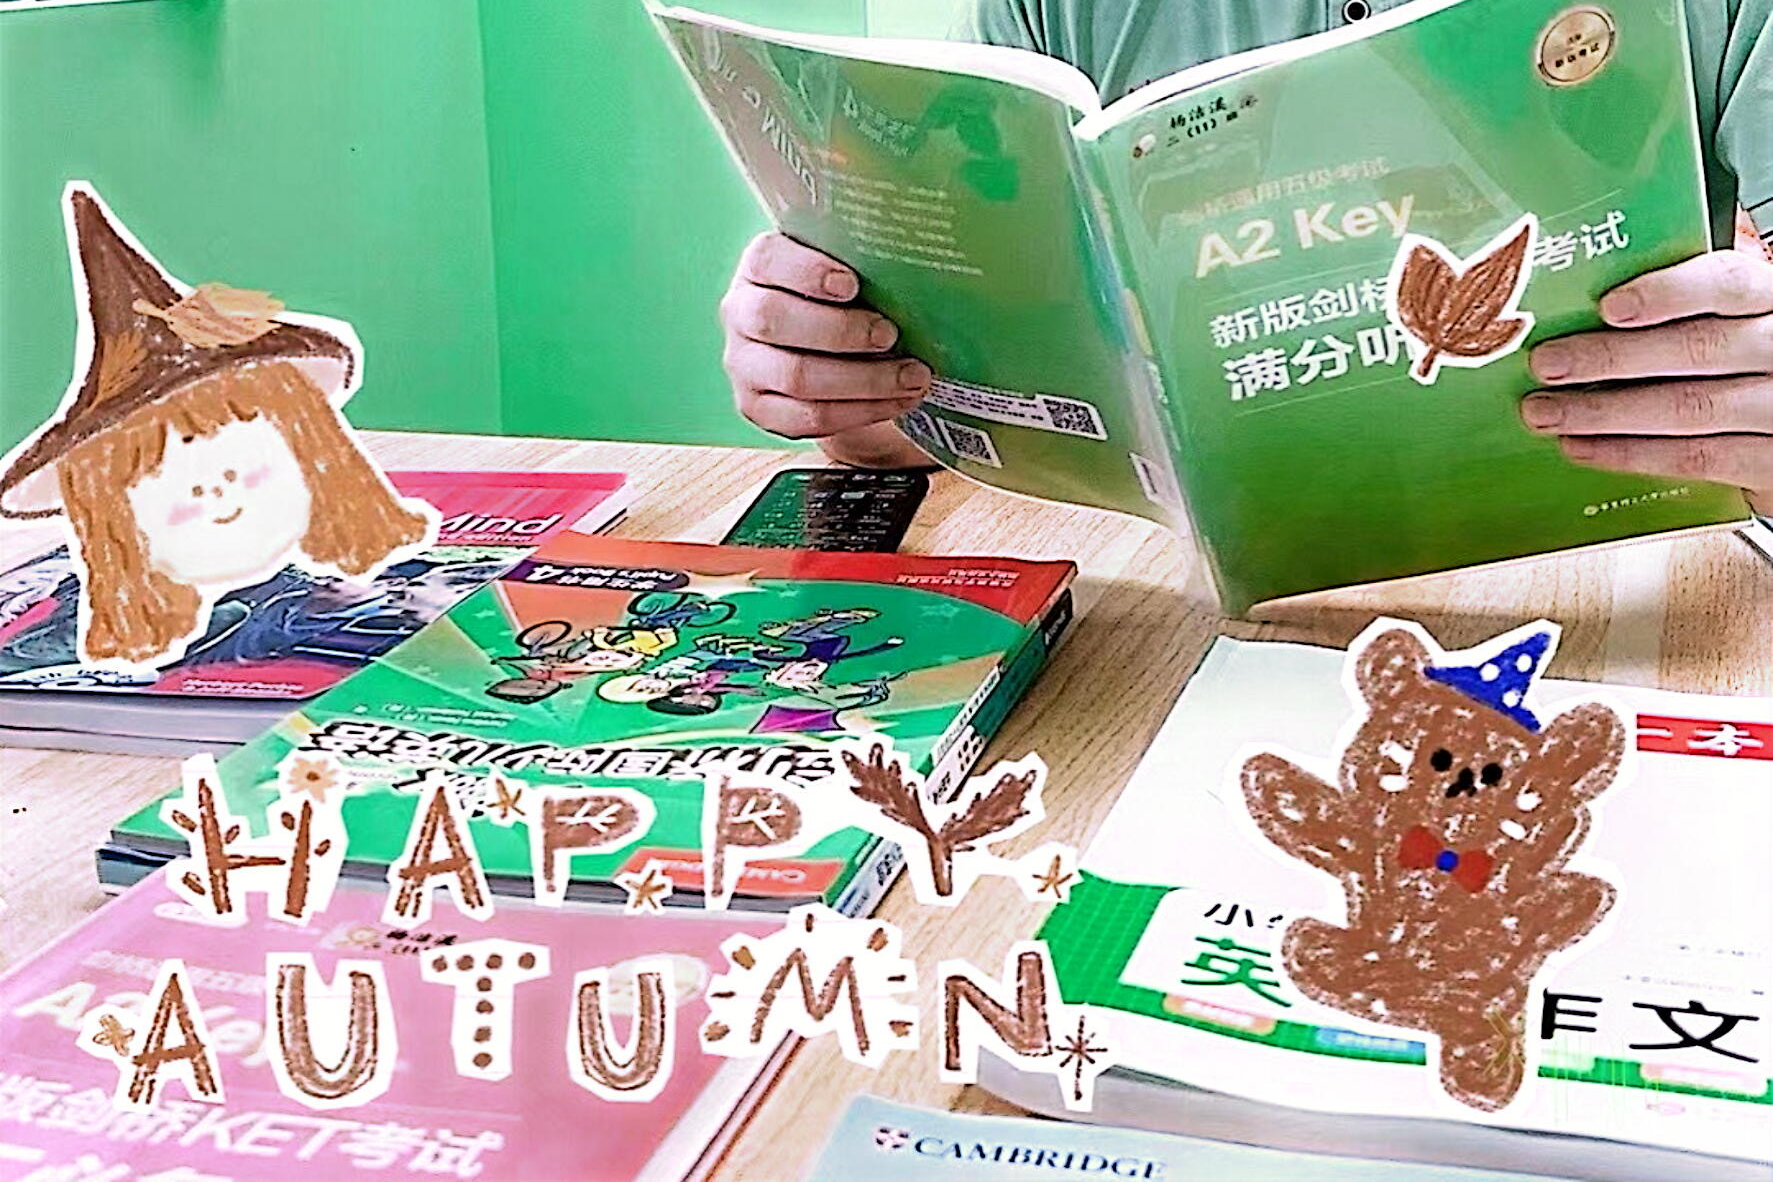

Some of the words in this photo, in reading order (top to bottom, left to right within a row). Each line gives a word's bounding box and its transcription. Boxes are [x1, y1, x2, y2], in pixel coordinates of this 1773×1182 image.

[1176, 156, 1391, 226] 通用五级考试
[1195, 218, 1280, 279] A2
[1293, 193, 1414, 250] Key
[1533, 209, 1630, 272] 考试
[526, 566, 565, 582] 4
[1204, 903, 1284, 929] 小
[914, 1136, 1167, 1179] CAMBRIDGE
